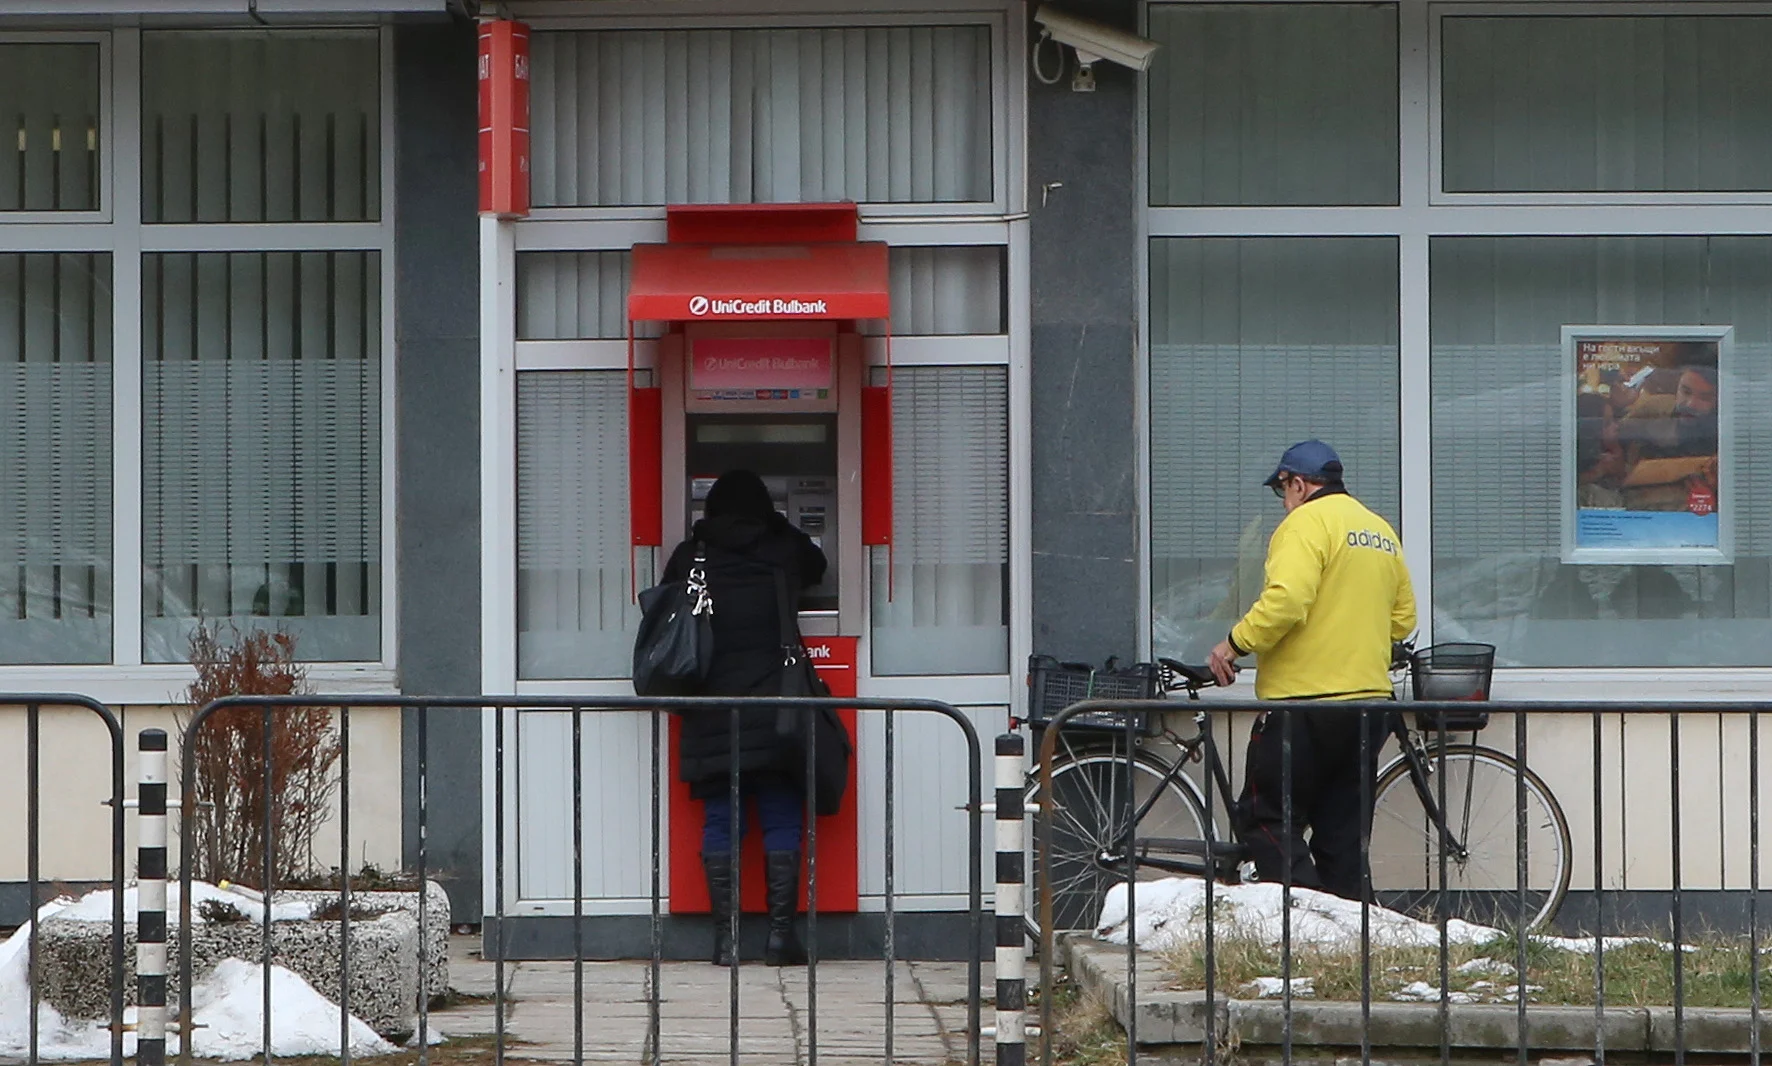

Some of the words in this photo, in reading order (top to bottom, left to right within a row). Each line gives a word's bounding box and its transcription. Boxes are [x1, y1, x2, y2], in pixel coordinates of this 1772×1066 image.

[711, 299, 771, 314] UniCredit
[773, 299, 827, 314] Bulbank
[1582, 343, 1597, 352] На
[719, 357, 770, 370] UniCredit
[772, 357, 819, 370] Bulbank
